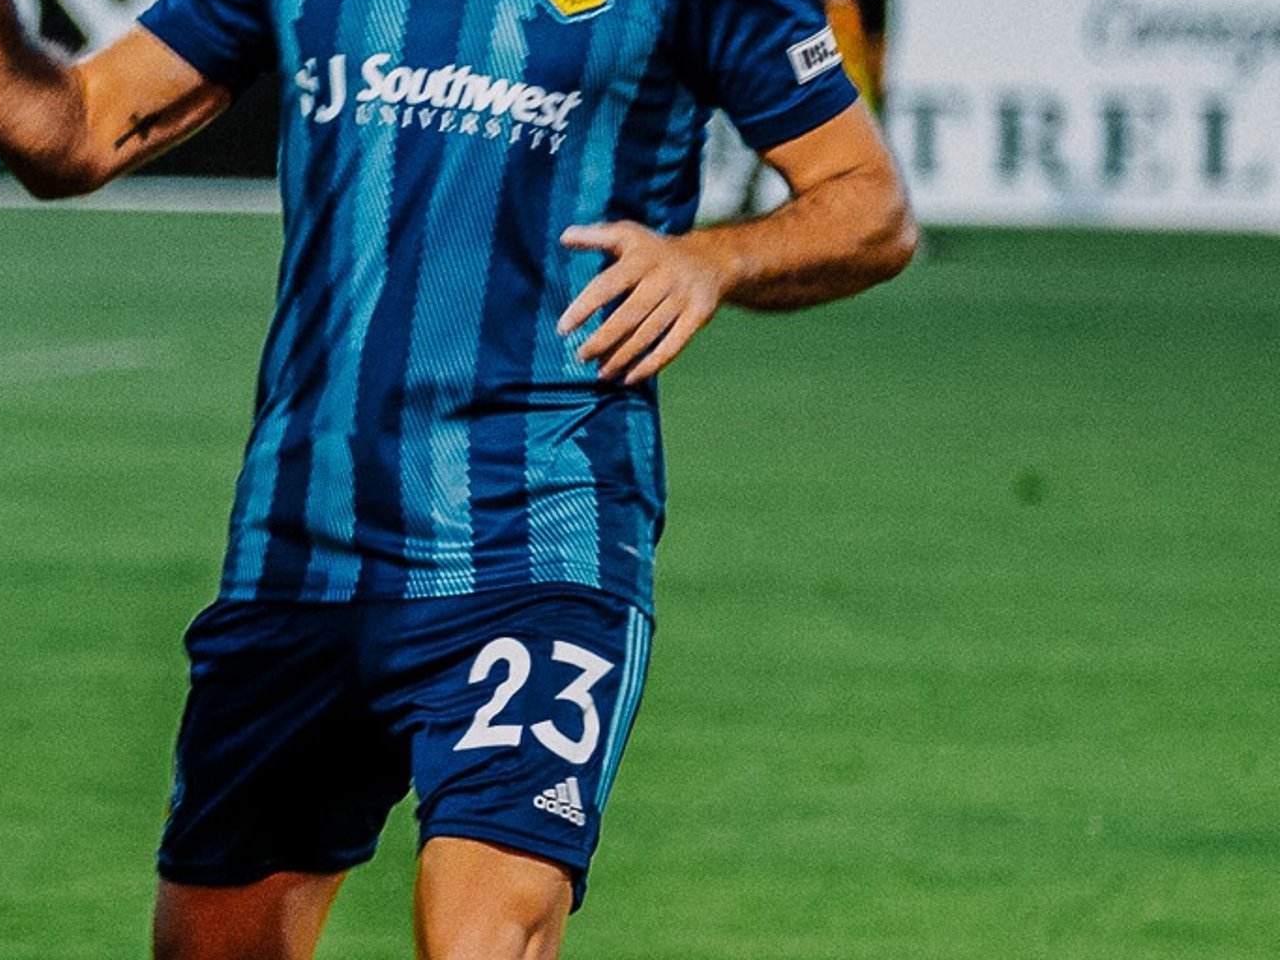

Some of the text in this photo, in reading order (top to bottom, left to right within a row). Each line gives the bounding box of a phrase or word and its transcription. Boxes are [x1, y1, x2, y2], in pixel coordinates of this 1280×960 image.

[355, 52, 584, 132] Southwest
[355, 102, 568, 155] UNIVERSITY
[453, 636, 616, 765] 23
